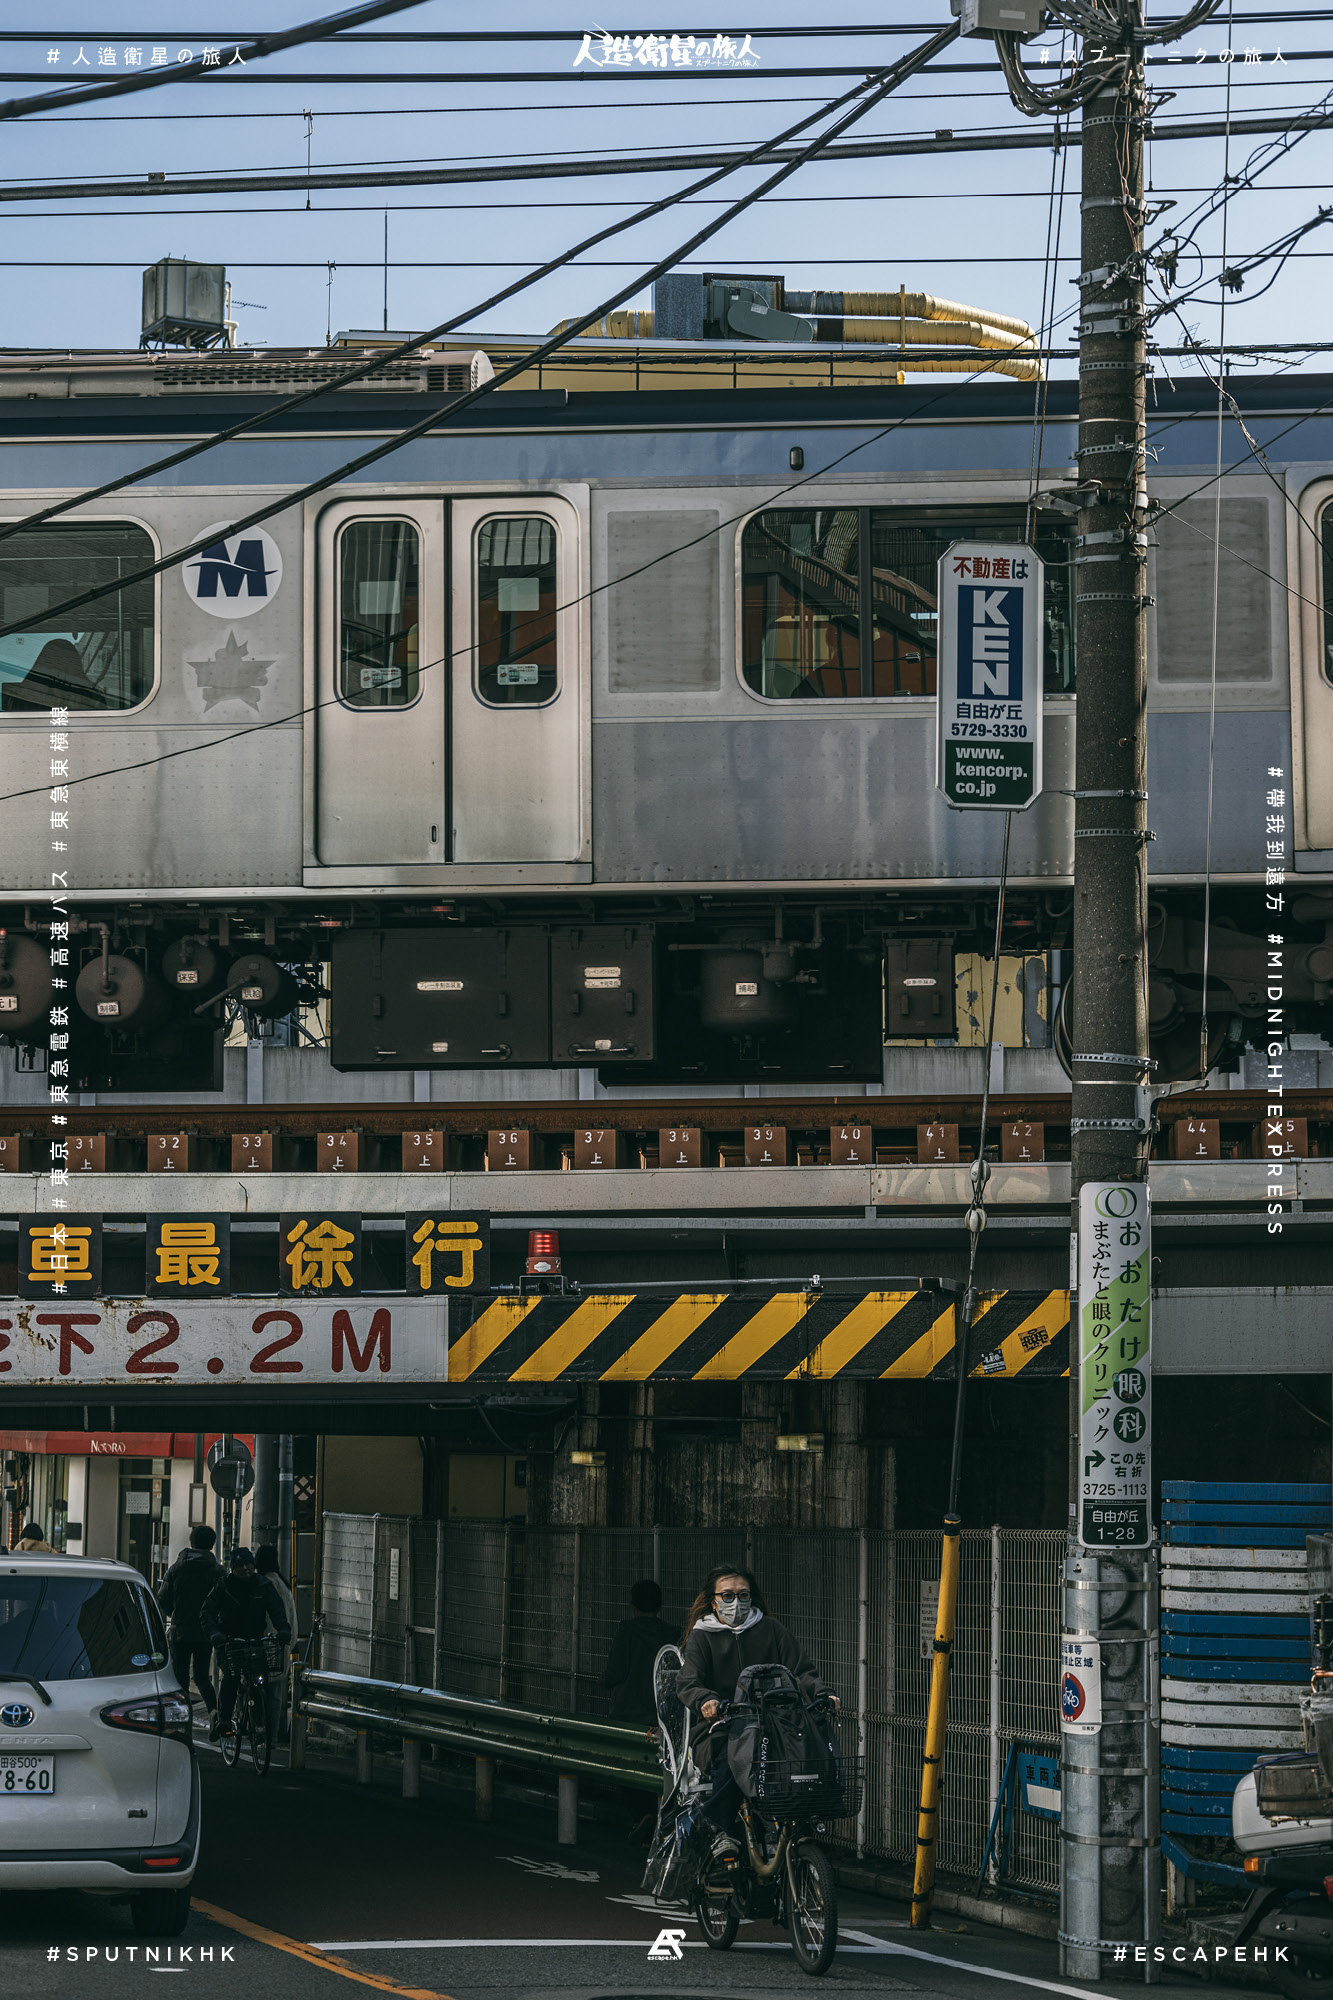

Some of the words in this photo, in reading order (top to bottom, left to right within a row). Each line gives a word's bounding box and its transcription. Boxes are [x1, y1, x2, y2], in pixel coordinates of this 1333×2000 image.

[952, 556, 1029, 580] 不動産は
[971, 589, 1010, 697] KEN
[956, 703, 1023, 721] 自由が丘
[951, 723, 1028, 738] 5729-3330
[955, 747, 1005, 760] www.
[955, 762, 1028, 781] kencorp.
[955, 780, 997, 797] co.jp
[178, 971, 197, 983] 保安
[840, 1128, 861, 1140] 40
[926, 1126, 946, 1138] 41
[1012, 1125, 1032, 1137] 42
[1187, 1122, 1207, 1134] 44
[327, 1135, 347, 1147] 34
[413, 1134, 433, 1146] 35
[498, 1133, 518, 1144] 36
[584, 1132, 605, 1143] 37
[669, 1131, 690, 1142] 38
[753, 1129, 773, 1141] 39
[75, 1138, 95, 1150] 31
[159, 1137, 180, 1149] 32
[242, 1136, 262, 1148] 33
[1283, 1141, 1295, 1153] 上
[847, 1149, 858, 1161] 上
[933, 1148, 946, 1160] 上
[1018, 1146, 1031, 1158] 上
[1195, 1143, 1208, 1156] 上
[247, 1156, 259, 1168] 上
[332, 1155, 344, 1168] 上
[419, 1155, 431, 1166] 上
[505, 1153, 517, 1165] 上
[590, 1152, 603, 1164] 上
[676, 1151, 688, 1163] 上
[760, 1150, 772, 1162] 上
[80, 1158, 93, 1170] 上
[163, 1157, 175, 1169] 上
[1092, 1220, 1112, 1444] まぶたと眼のクリニック
[1119, 1221, 1143, 1439] おおたけ眼科
[1110, 1452, 1146, 1465] この先
[1114, 1465, 1143, 1478] 右折
[1083, 1482, 1148, 1496] 3725-1113
[1092, 1509, 1140, 1523] 自由が丘
[1097, 1527, 1136, 1540] 1-28
